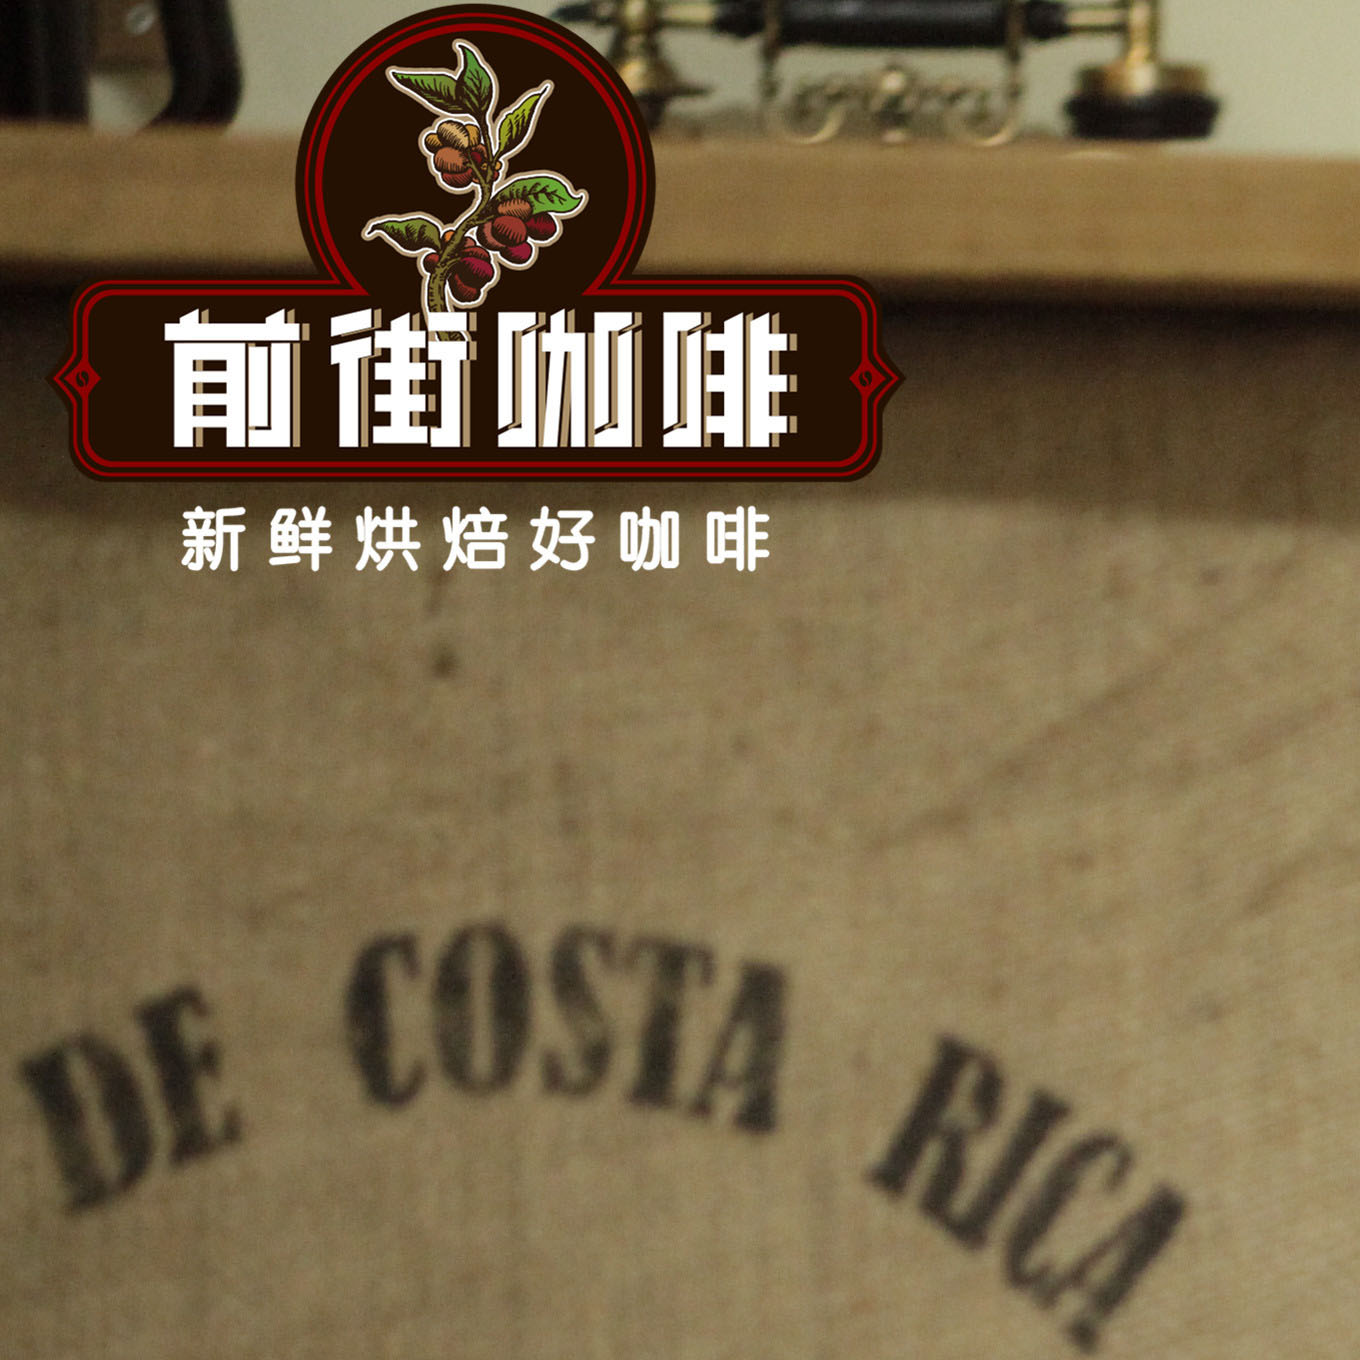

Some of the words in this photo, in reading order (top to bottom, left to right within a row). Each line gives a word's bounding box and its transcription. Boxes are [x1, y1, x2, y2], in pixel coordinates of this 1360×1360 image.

[18, 987, 242, 1214] DE
[345, 920, 792, 1134] COSTA
[866, 1032, 1188, 1356] RICA
